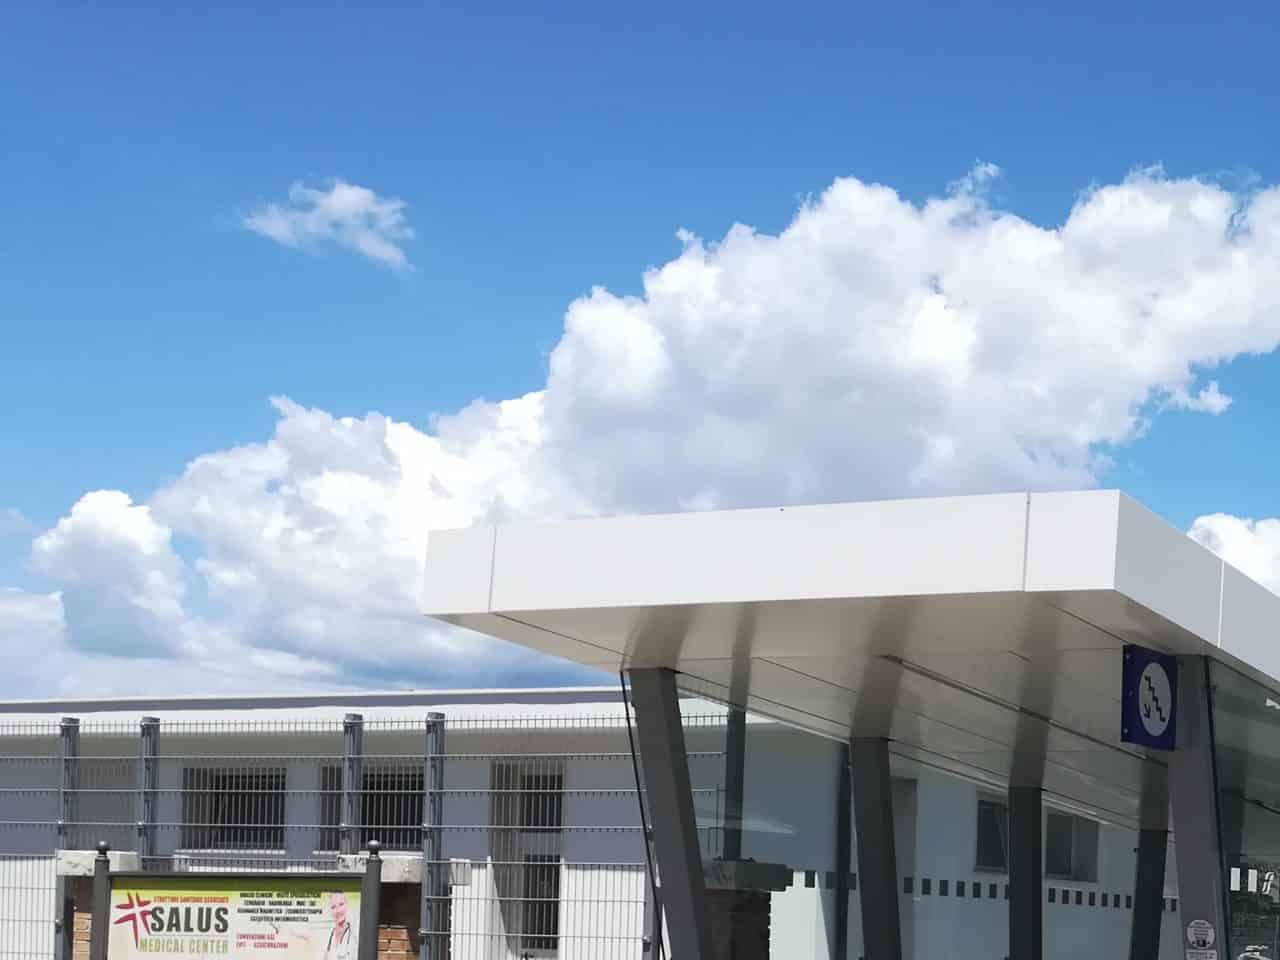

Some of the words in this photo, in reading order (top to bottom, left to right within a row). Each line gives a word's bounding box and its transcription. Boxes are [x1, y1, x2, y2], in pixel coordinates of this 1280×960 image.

[151, 906, 229, 933] SALUS
[139, 938, 184, 953] MEDICAL
[189, 938, 228, 954] CENTER
